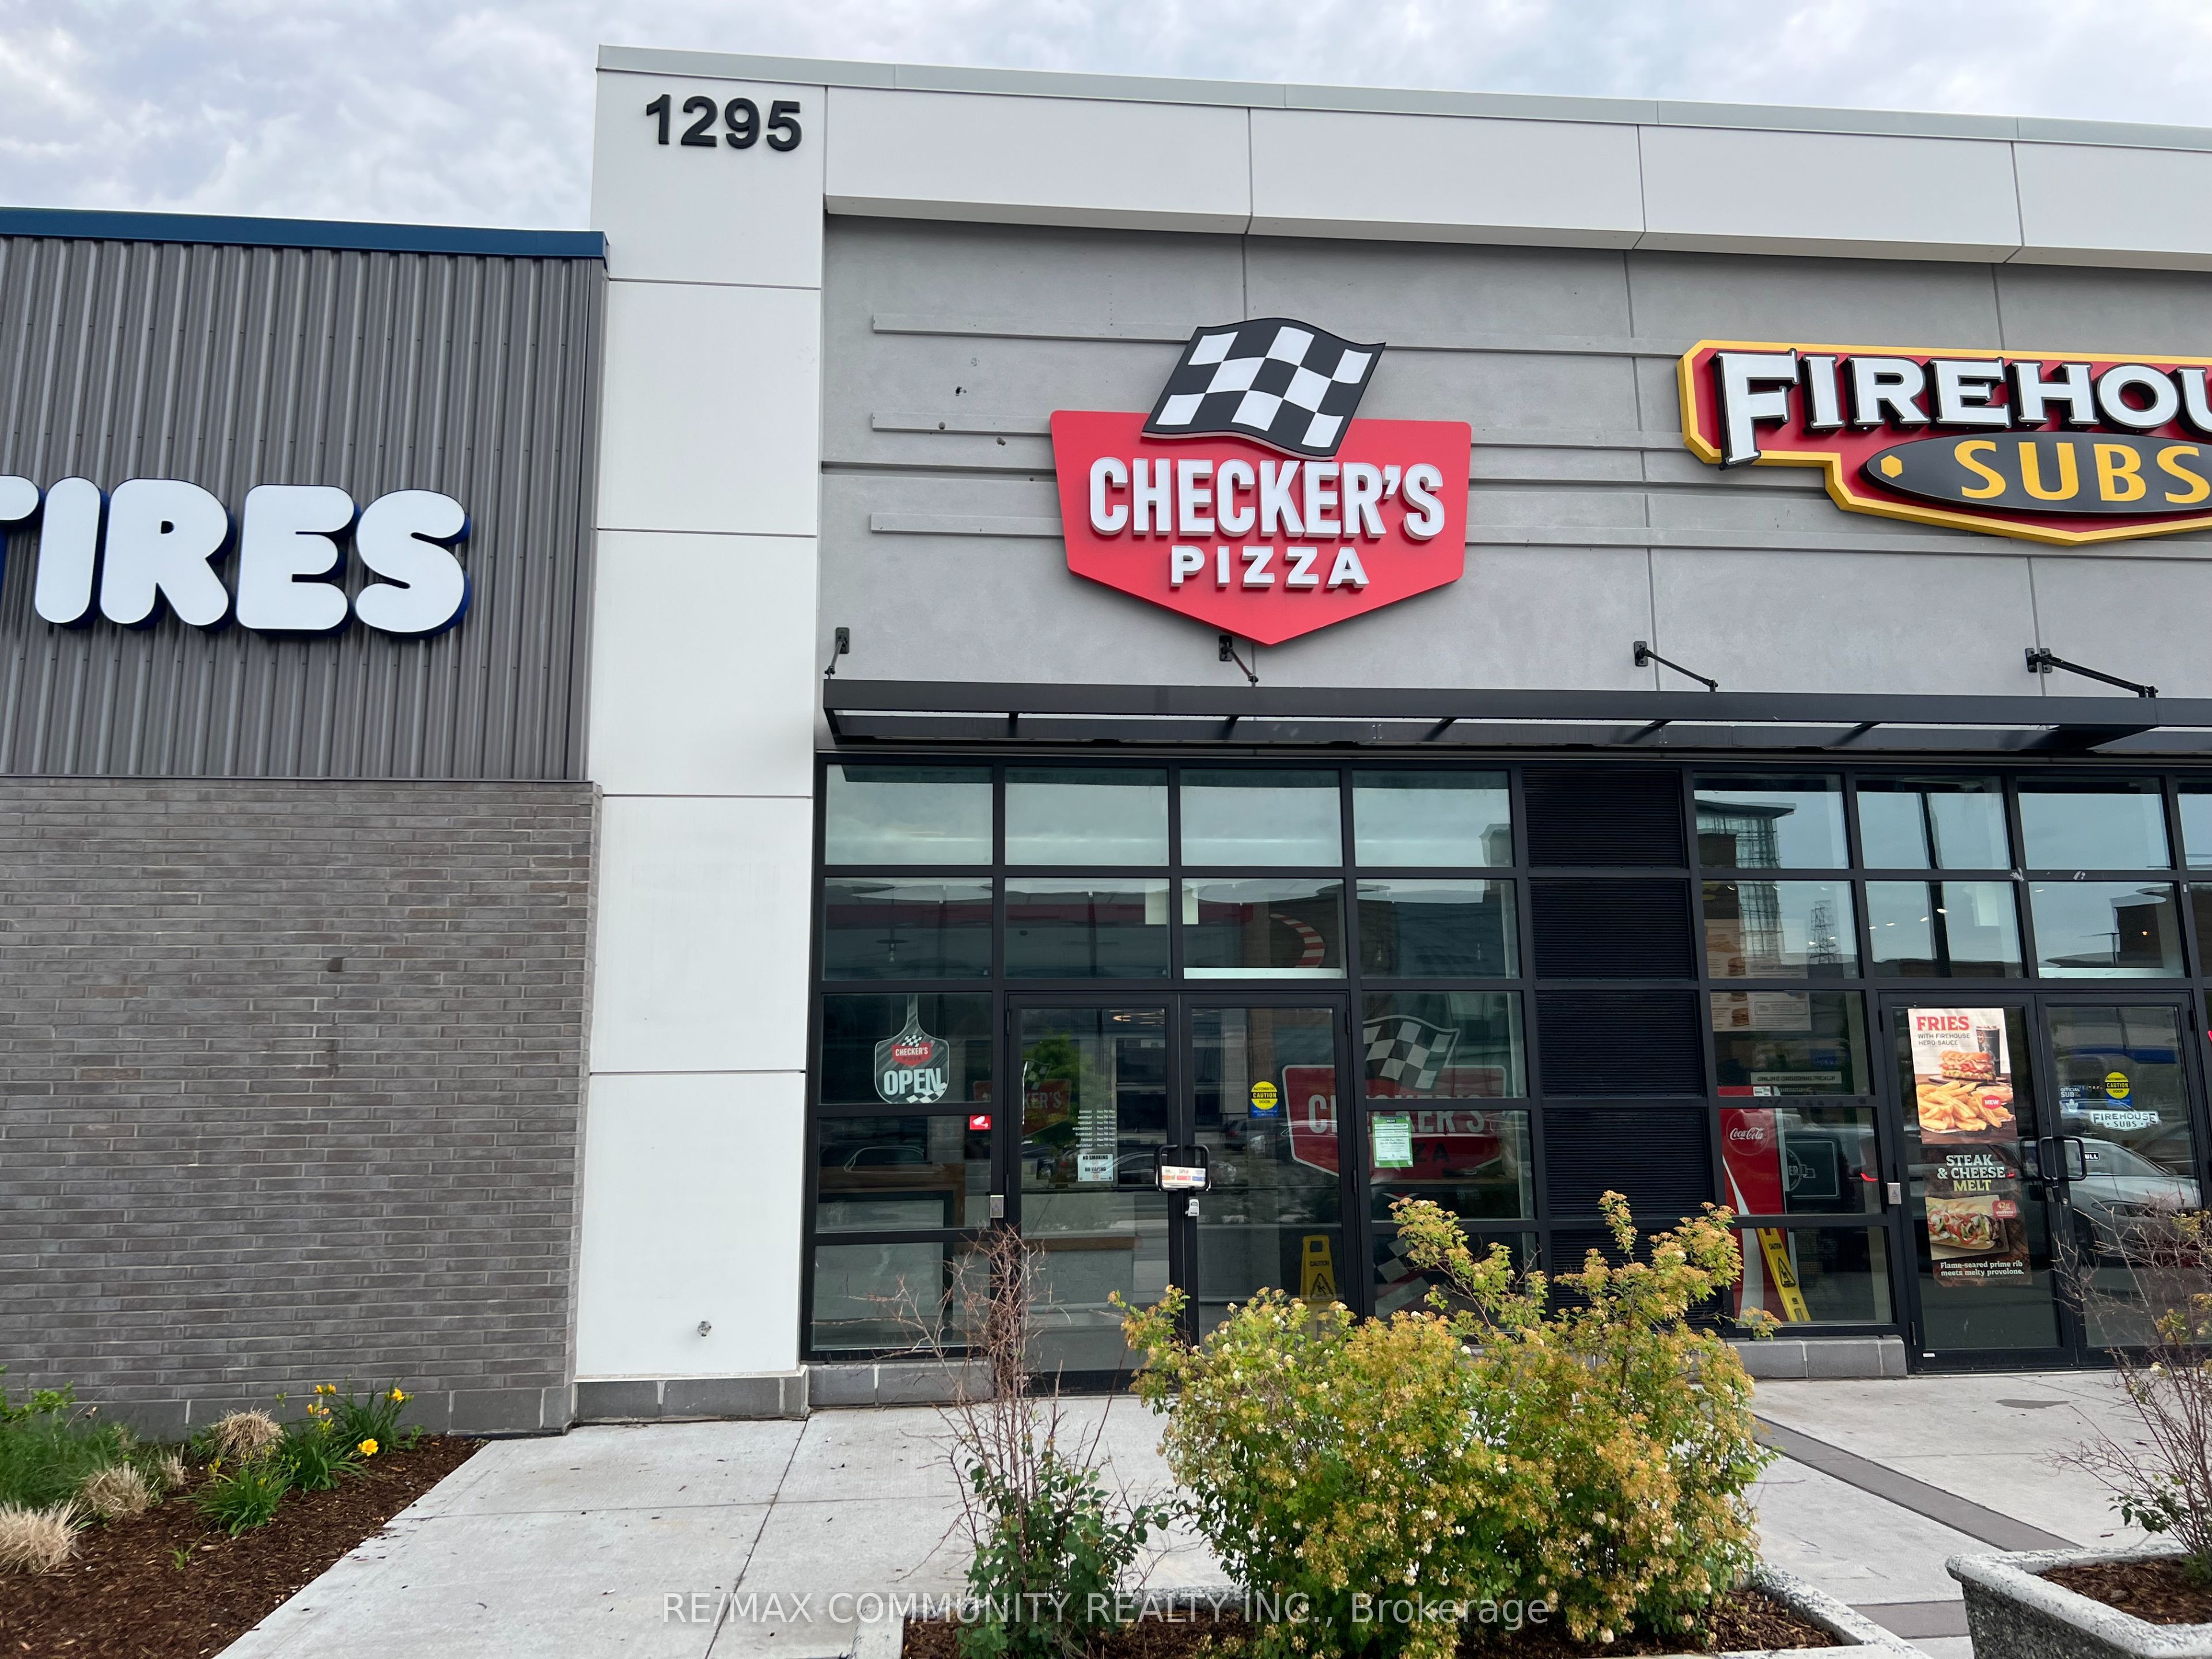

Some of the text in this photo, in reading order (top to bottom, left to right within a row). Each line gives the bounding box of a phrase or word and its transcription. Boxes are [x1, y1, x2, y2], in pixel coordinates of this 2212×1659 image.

[646, 94, 802, 151] 1295
[1954, 440, 2211, 504] SUBS
[1090, 457, 1445, 540] CHECKER'S
[1171, 546, 1369, 589] PIZZA
[1916, 1016, 1969, 1031] FRIES
[895, 1047, 928, 1056] CHECKER'S
[884, 1068, 941, 1095] OPEN
[2093, 1113, 2156, 1123] FIREHOUSE
[1730, 1127, 1764, 1141] Coca-Cola
[1946, 1154, 1993, 1166] STEAK
[1937, 1166, 2006, 1179] & CHEESE
[1953, 1180, 1991, 1192] MELT
[1990, 1261, 2011, 1269] prime
[1965, 1269, 1985, 1277] melty
[1987, 1268, 2024, 1277] provolone.
